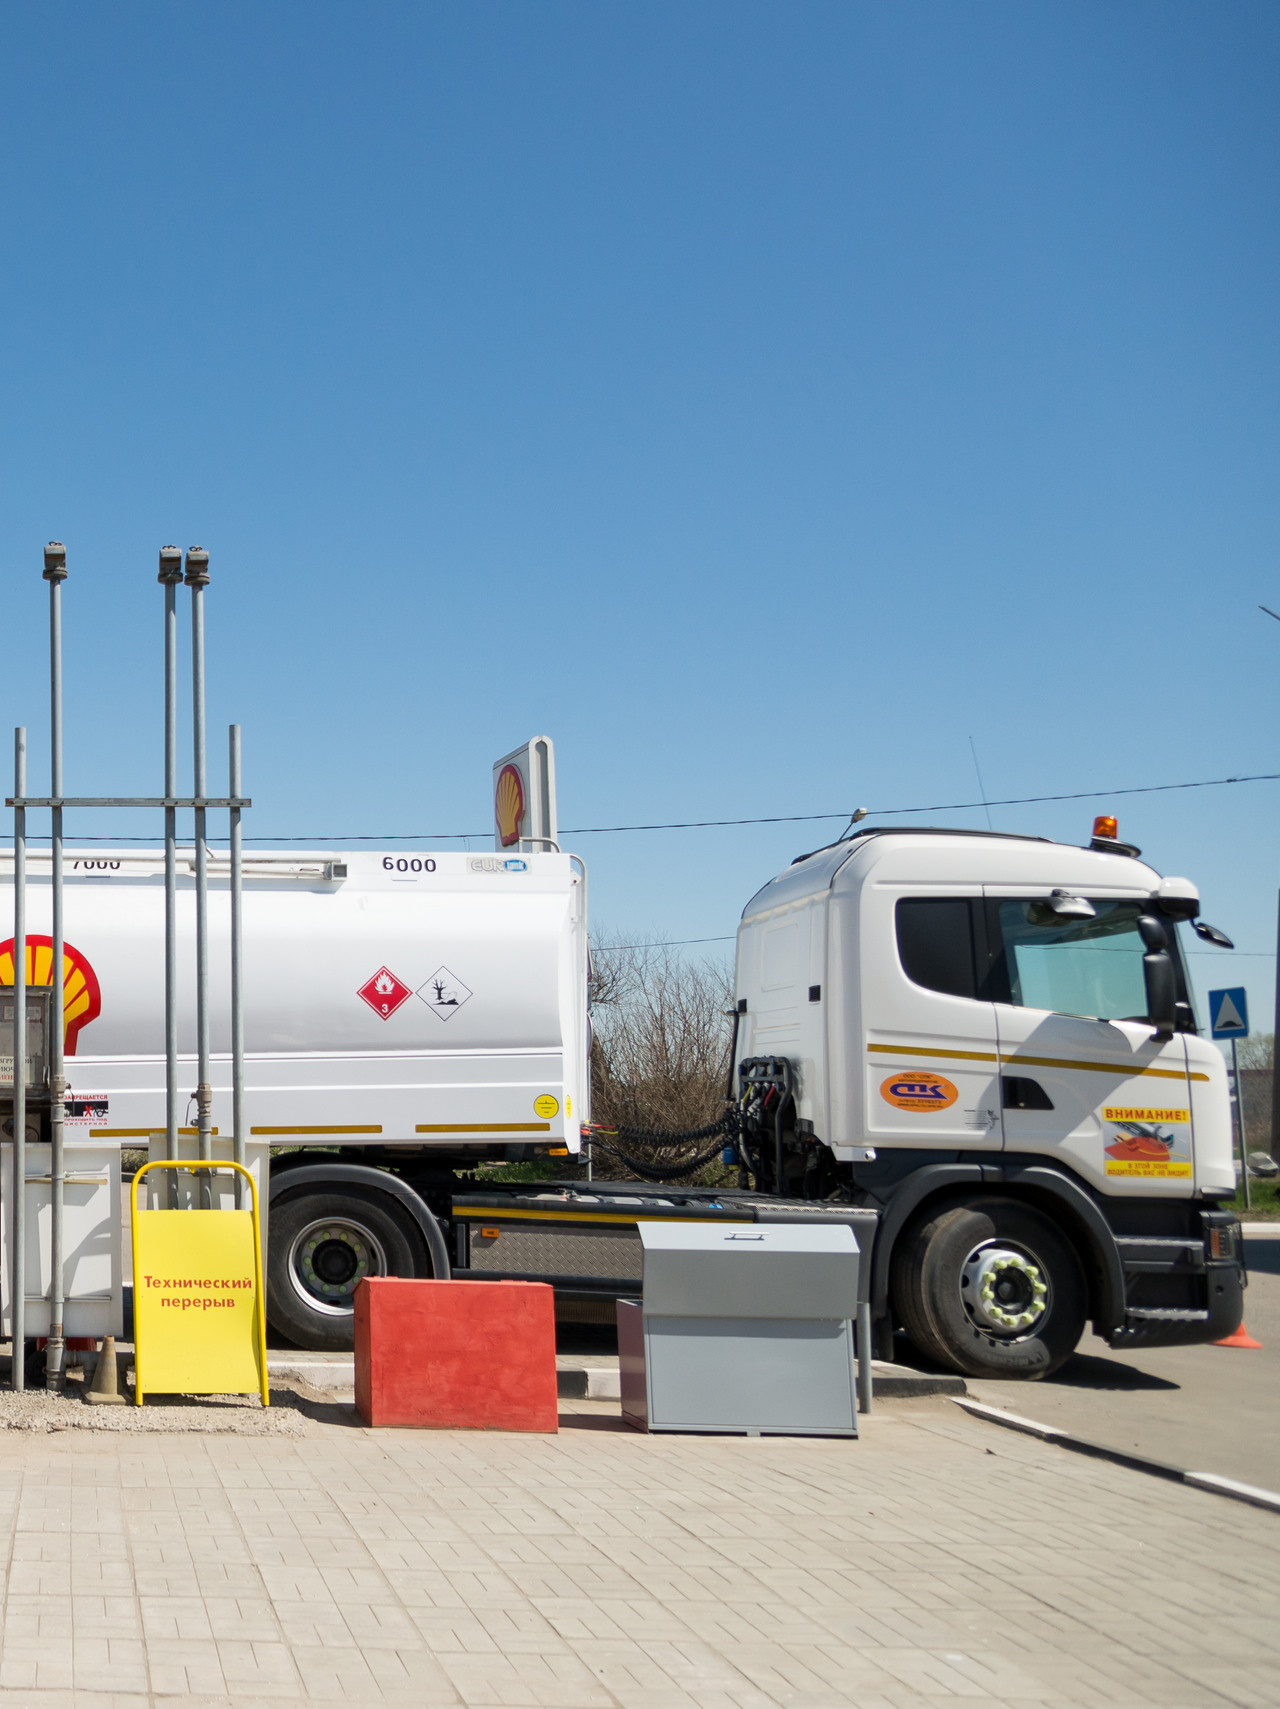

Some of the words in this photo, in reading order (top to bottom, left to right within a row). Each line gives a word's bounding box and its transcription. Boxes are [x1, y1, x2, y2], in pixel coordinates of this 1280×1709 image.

[383, 856, 437, 872] 6000
[381, 1003, 390, 1014] 3
[1105, 1109, 1186, 1121] ВНИМАНИЕ!
[144, 1275, 252, 1289] Технический
[161, 1297, 235, 1311] перерыв
